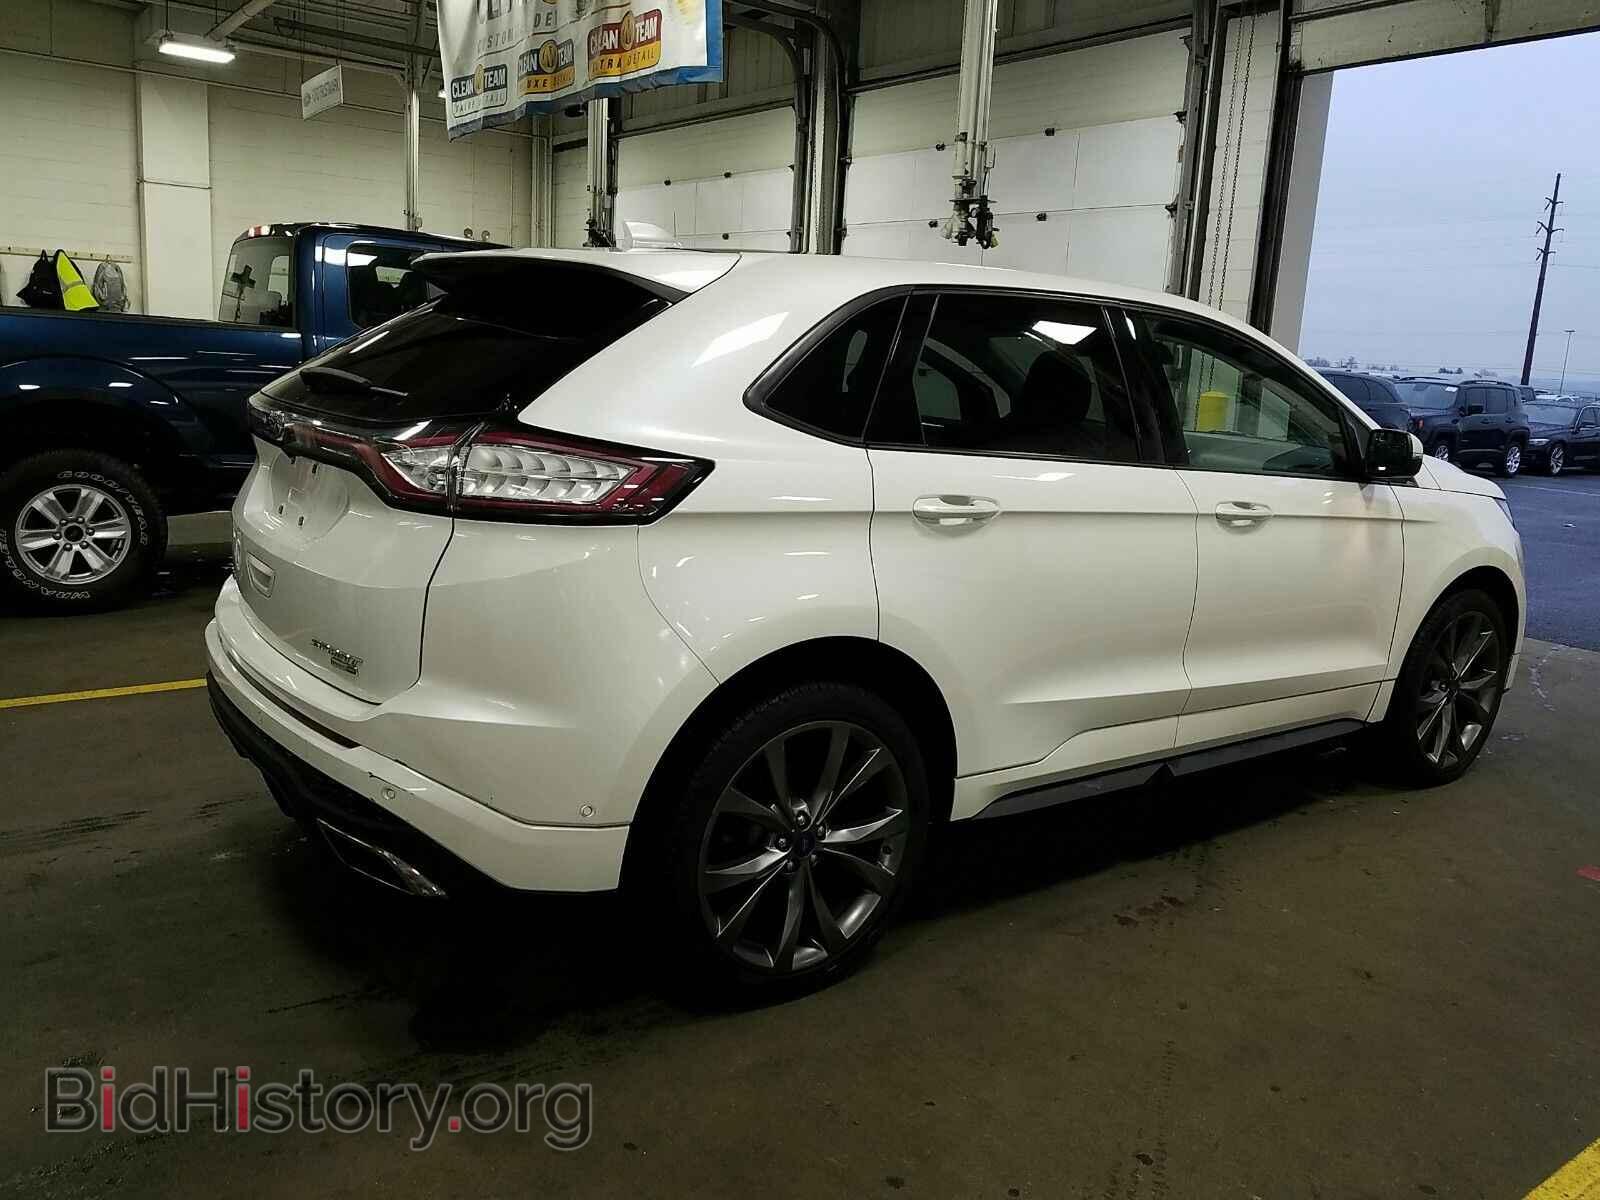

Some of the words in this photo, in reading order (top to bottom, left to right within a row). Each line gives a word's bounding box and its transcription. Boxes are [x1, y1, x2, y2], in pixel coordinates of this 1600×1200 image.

[590, 29, 618, 54] CLEAN
[635, 16, 657, 43] TEAM
[452, 78, 474, 98] CLEAN
[484, 69, 506, 88] TEAM
